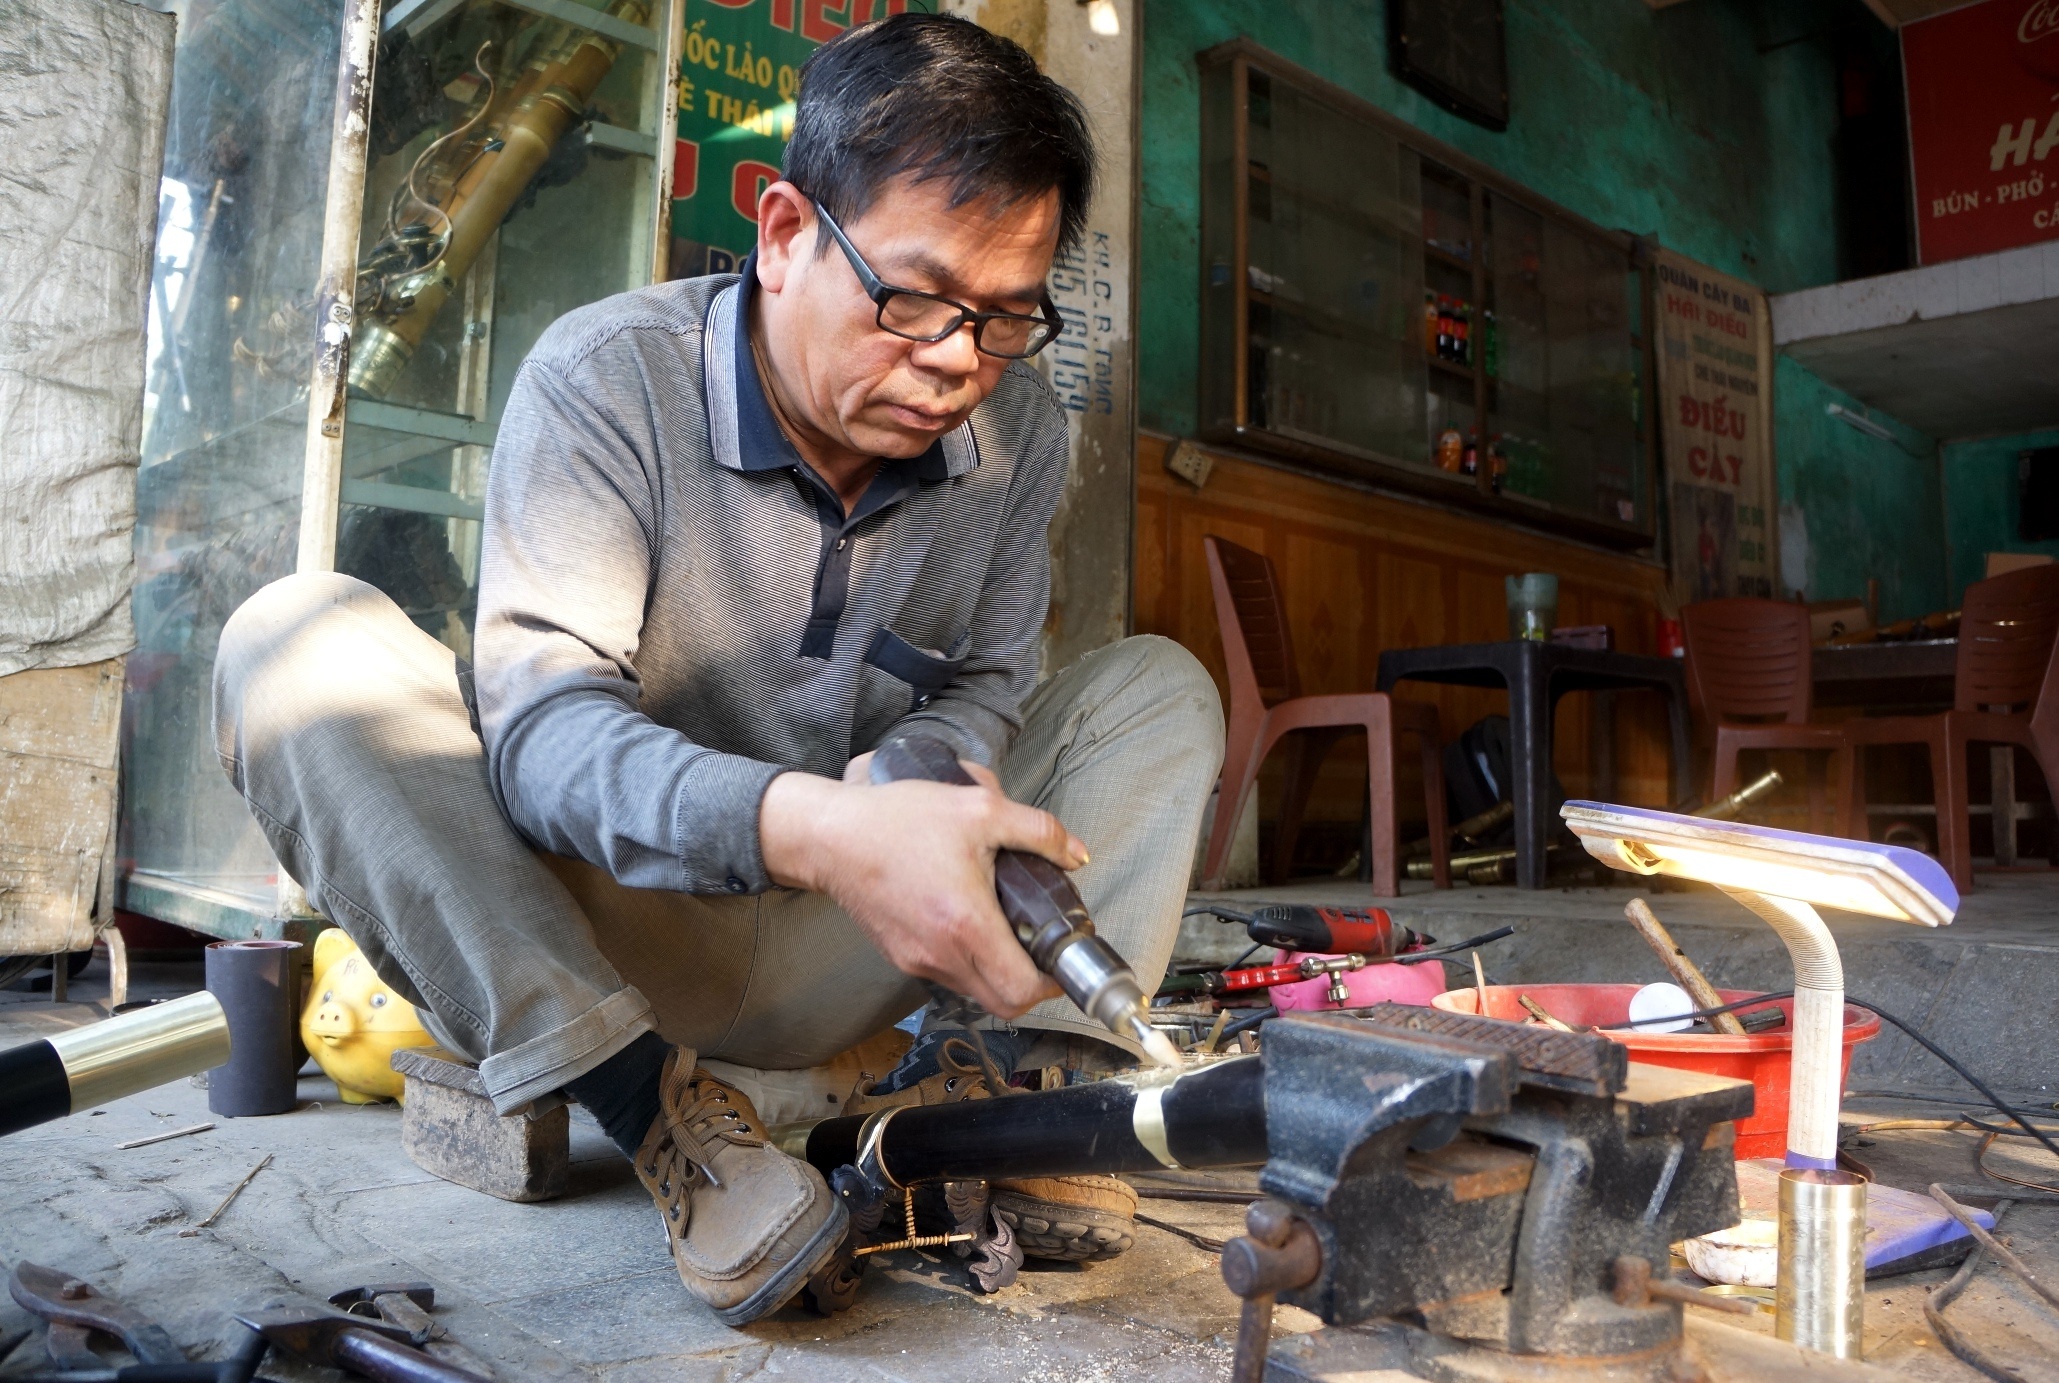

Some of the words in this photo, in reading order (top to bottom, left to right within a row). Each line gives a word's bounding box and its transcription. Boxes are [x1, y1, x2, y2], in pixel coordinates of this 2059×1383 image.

[682, 19, 720, 70] ỐC
[725, 41, 773, 88] LÀO
[705, 88, 773, 137] THÁI
[1932, 190, 1979, 218] BÚN
